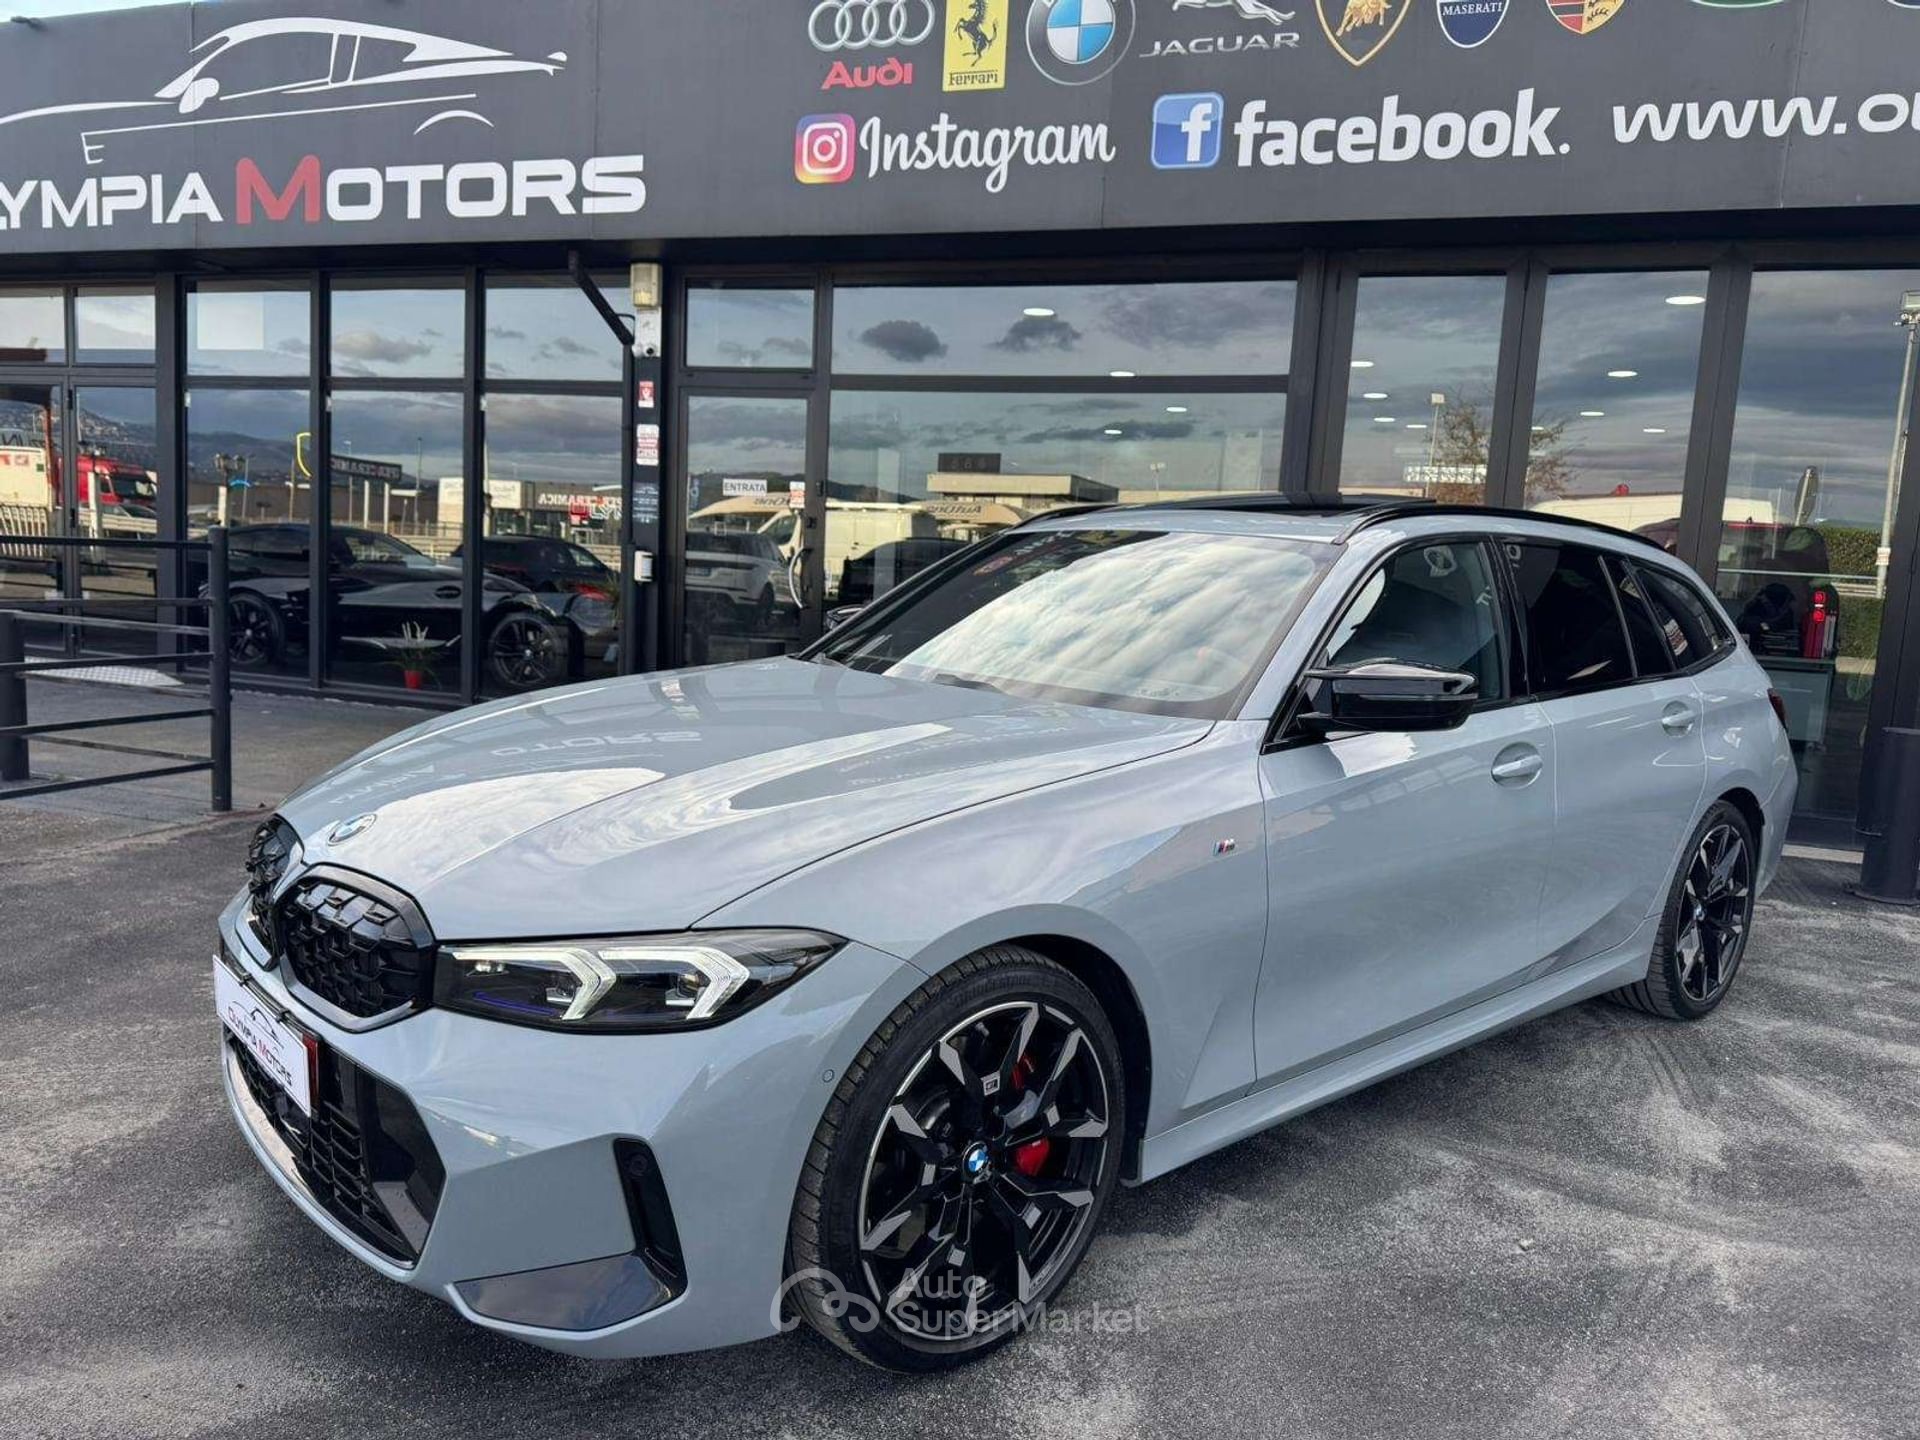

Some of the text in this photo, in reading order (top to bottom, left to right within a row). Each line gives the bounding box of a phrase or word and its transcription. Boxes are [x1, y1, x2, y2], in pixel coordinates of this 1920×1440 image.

[1442, 2, 1503, 16] MASERATI
[1139, 32, 1301, 58] JAGUAR
[821, 57, 914, 91] Audi
[947, 69, 1000, 87] Ferrari
[1232, 87, 1571, 169] facebook.
[1612, 92, 1920, 144] www.o
[859, 111, 1117, 194] Instagram
[0, 154, 647, 231] YMPIA MOTORS
[724, 481, 766, 492] ENTRATA
